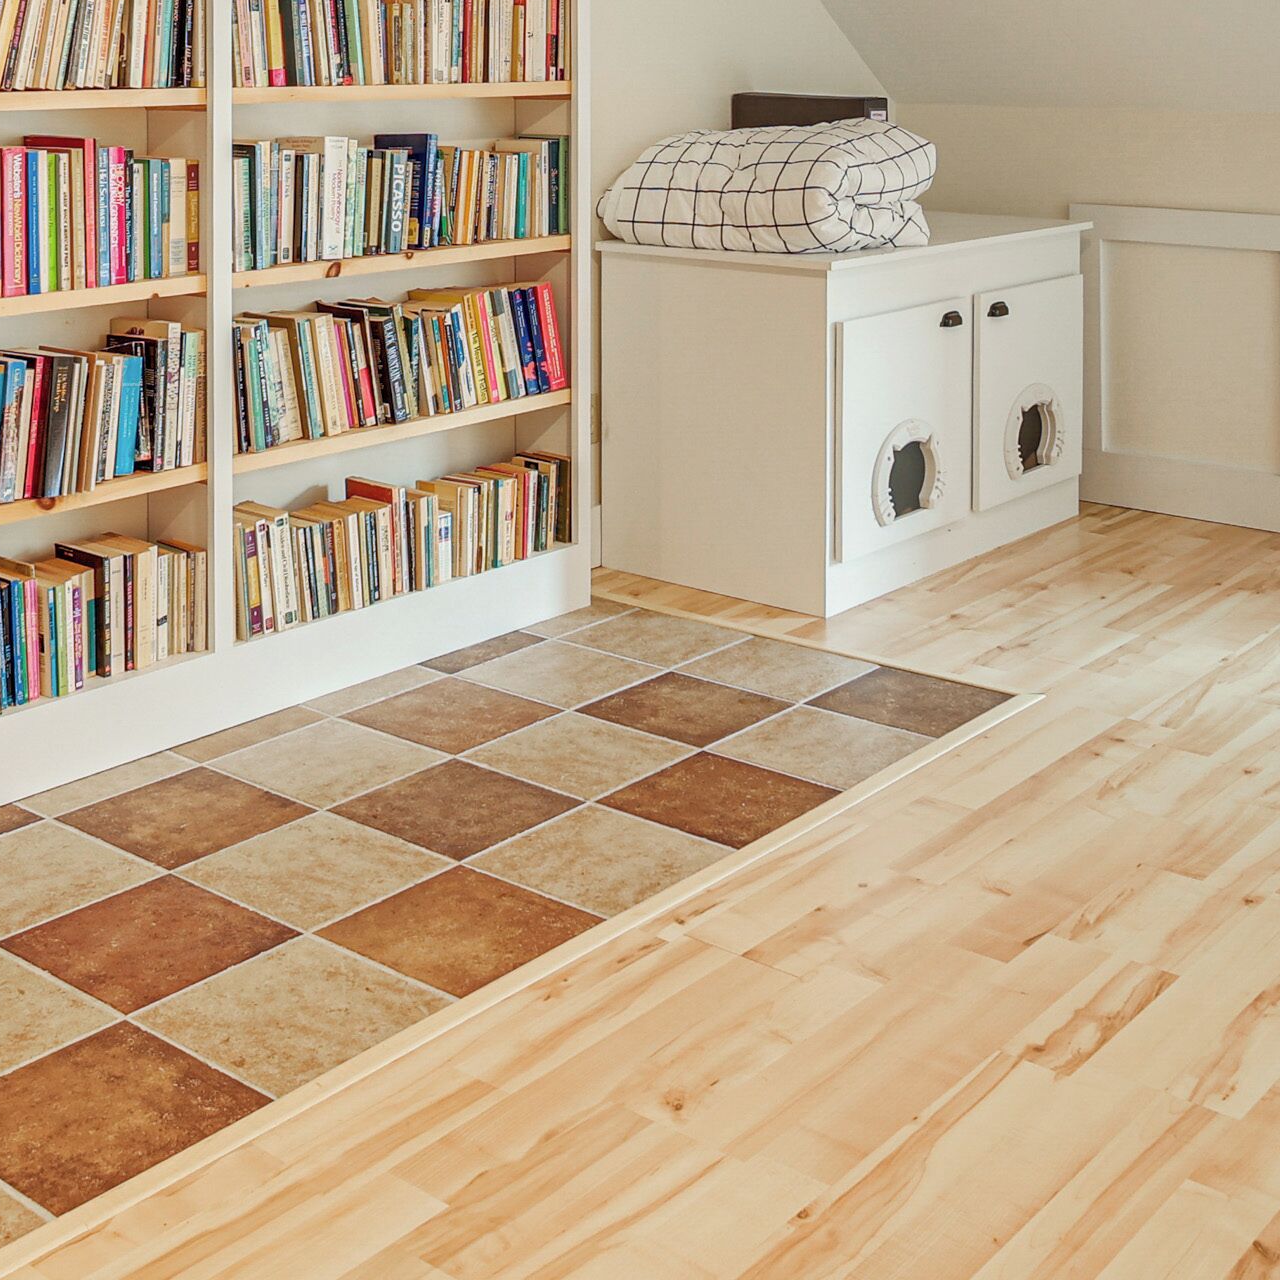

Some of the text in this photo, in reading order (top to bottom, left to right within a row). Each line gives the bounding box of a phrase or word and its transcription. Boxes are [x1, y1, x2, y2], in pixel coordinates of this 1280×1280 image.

[14, 153, 22, 198] Webster's
[392, 164, 404, 232] PICASSO
[384, 322, 400, 381] BLACK MOUNTAIN
